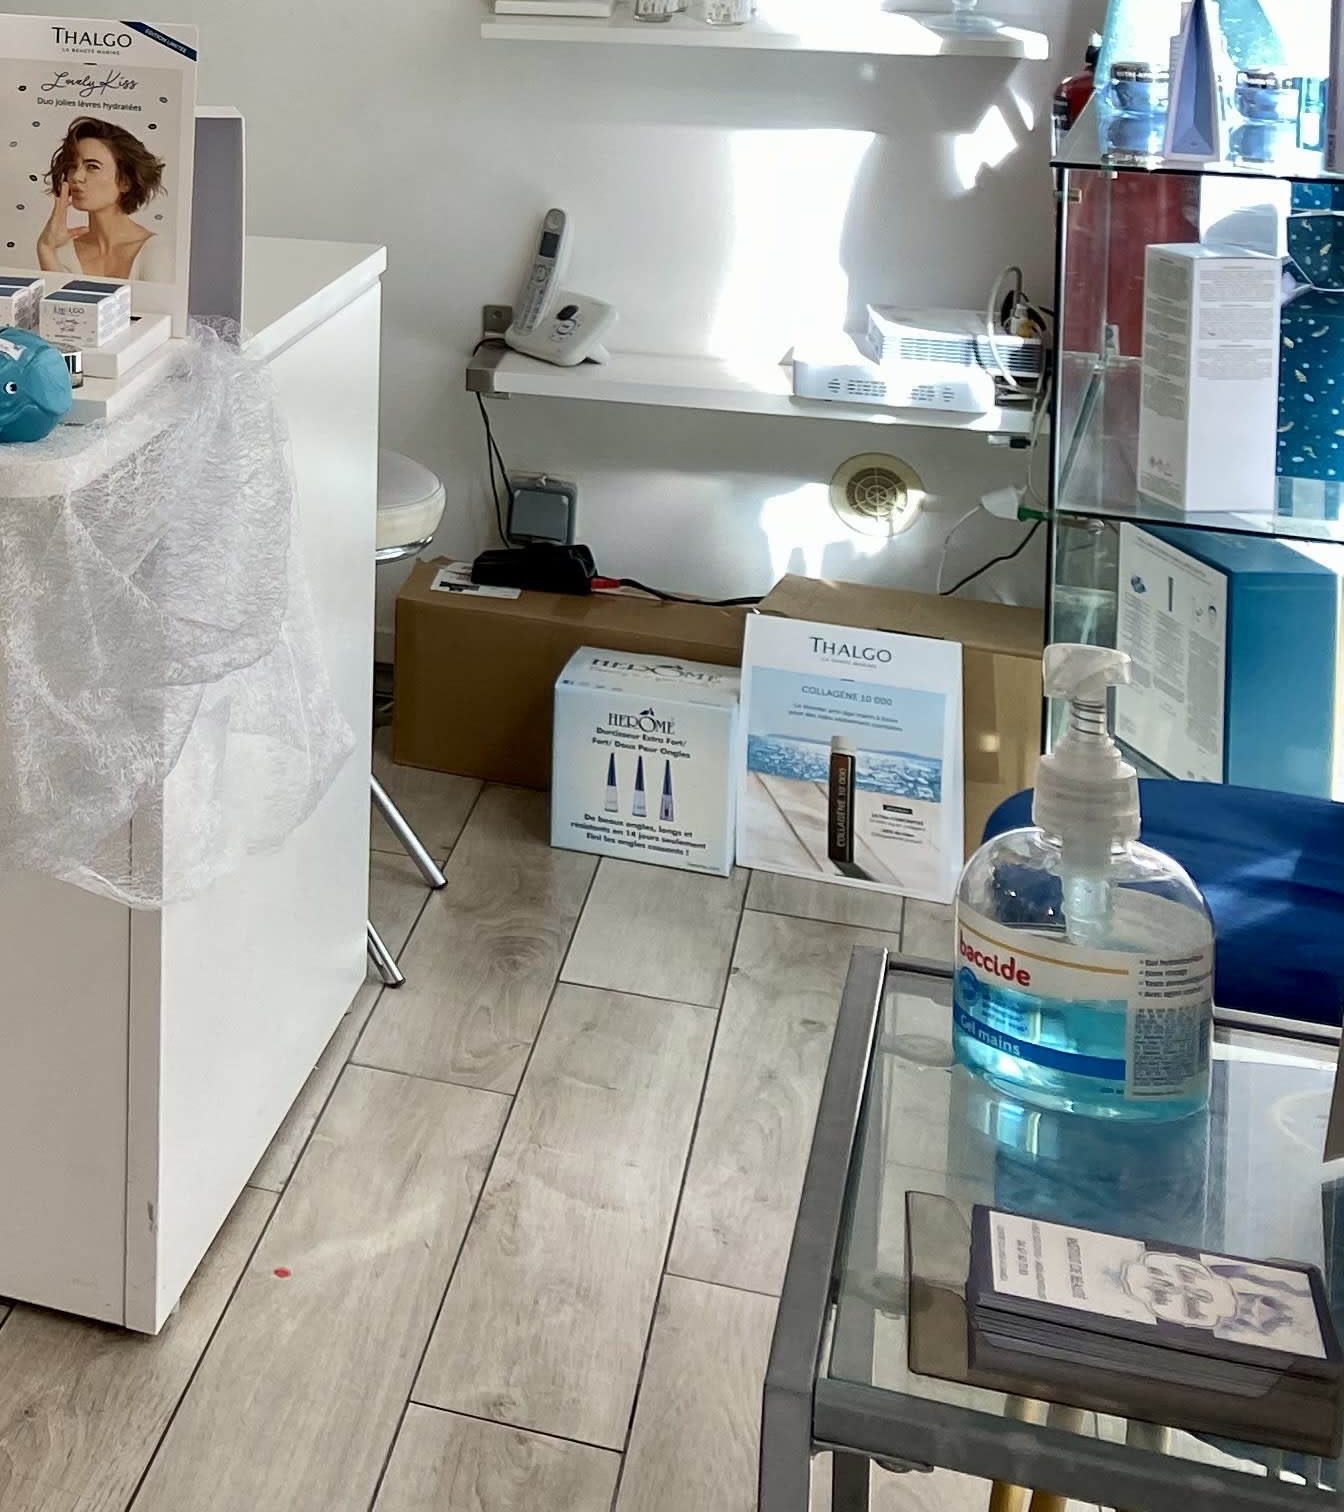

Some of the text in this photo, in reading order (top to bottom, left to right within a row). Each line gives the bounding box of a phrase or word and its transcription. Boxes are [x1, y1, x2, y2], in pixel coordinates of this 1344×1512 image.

[51, 26, 133, 48] THALGO
[41, 69, 139, 97] Lovely Kiss
[37, 97, 53, 106] Duo
[102, 100, 142, 112] hydratées
[809, 636, 892, 663] THALGO
[960, 928, 1031, 987] baccide
[977, 1029, 1021, 1057] mains
